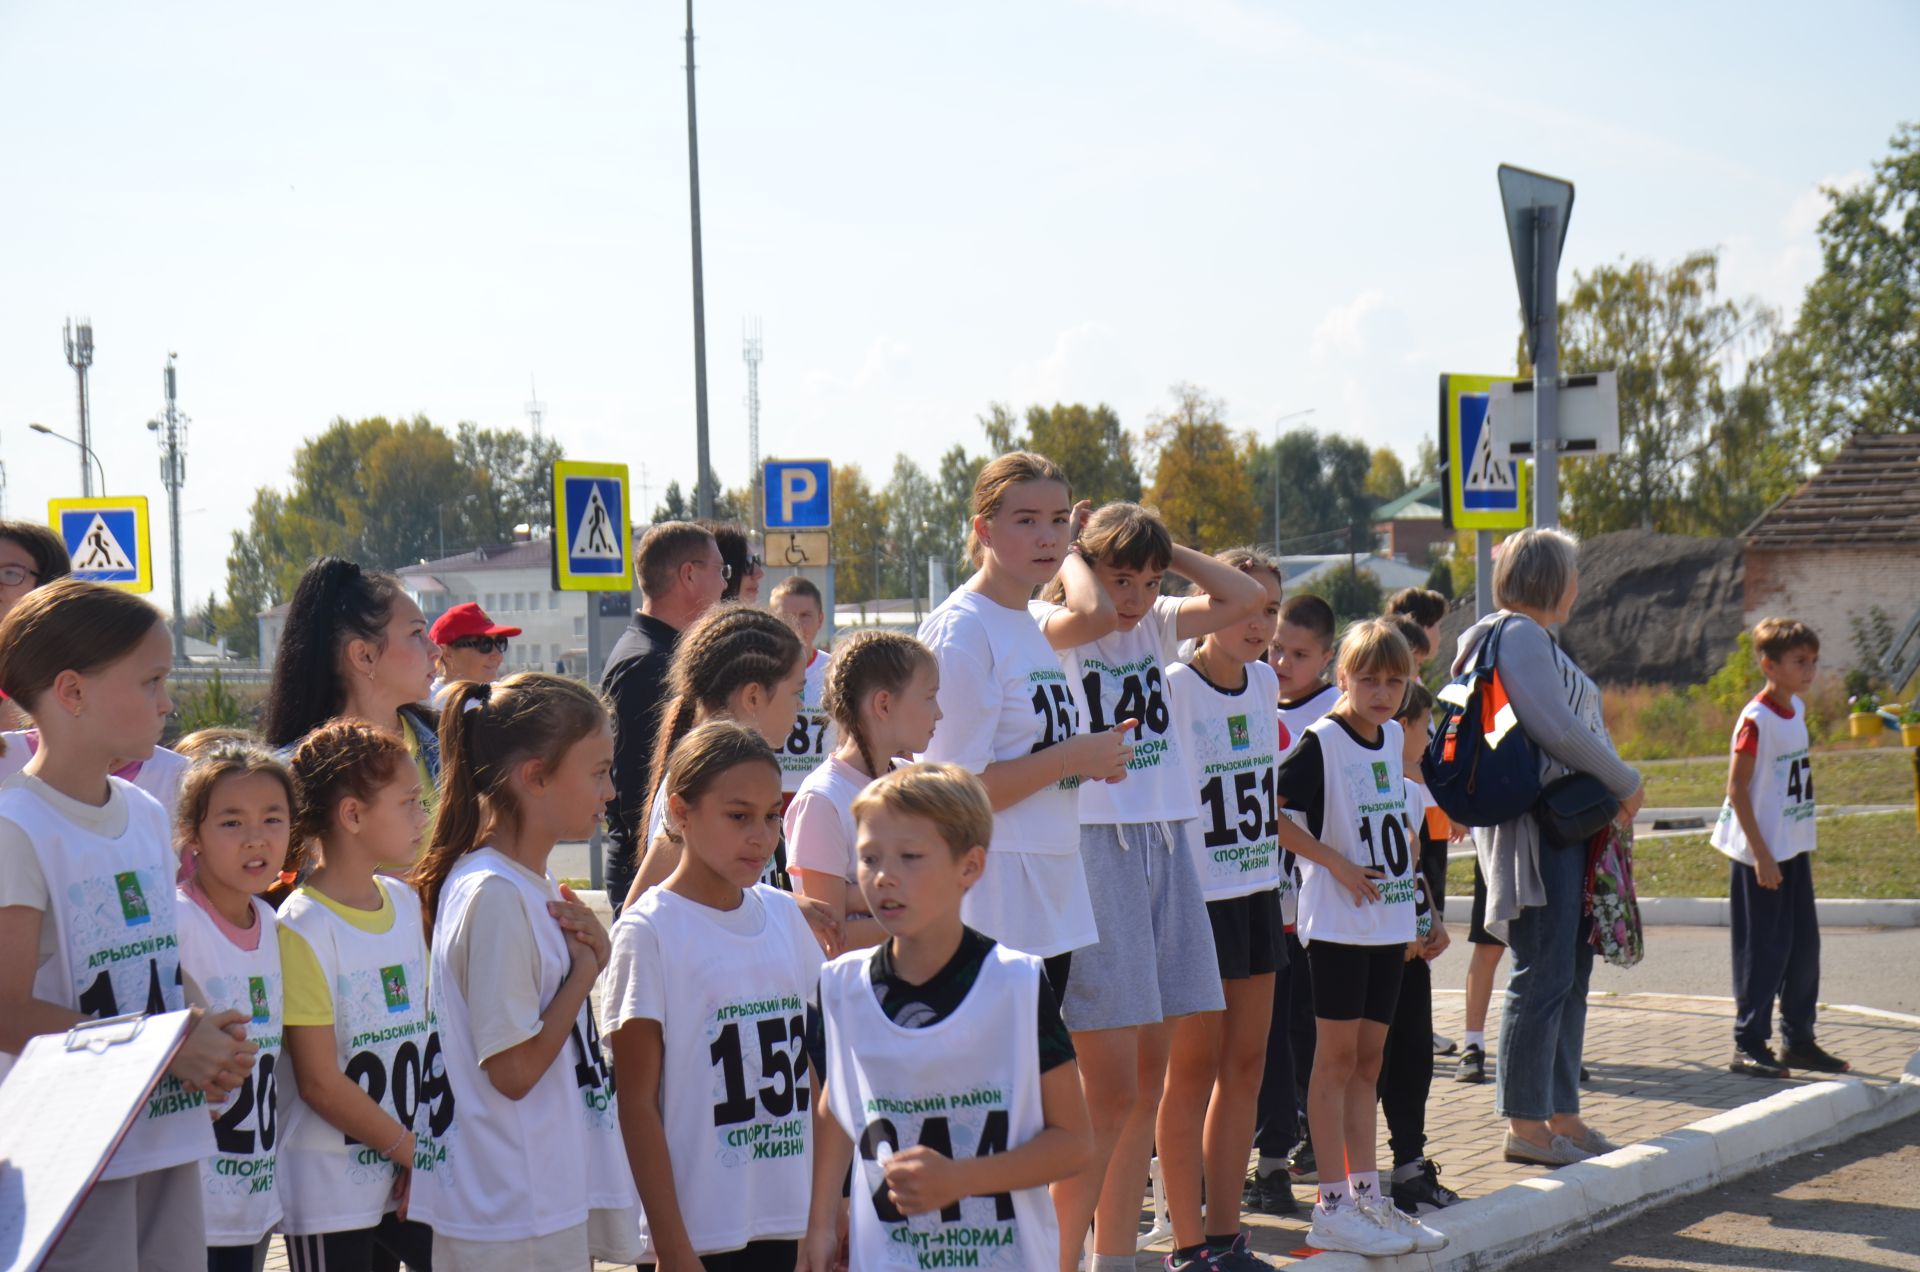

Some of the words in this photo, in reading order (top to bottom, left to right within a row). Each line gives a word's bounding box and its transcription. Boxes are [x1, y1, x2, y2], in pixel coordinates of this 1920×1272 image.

[781, 468, 817, 522] P
[1084, 658, 1135, 677] АГРЫСКИЙ
[1082, 667, 1169, 740] 148
[1126, 755, 1160, 770] ИЗНИ
[1204, 757, 1252, 774] АГРЫЗСКИЙ
[1200, 767, 1278, 848] 151
[1214, 847, 1251, 862] СПОРТ
[1240, 856, 1270, 872] ЖИЗНИ
[1384, 891, 1415, 904] ЖИЗН
[710, 1014, 810, 1127] 152
[950, 1089, 1003, 1109] РАЙОН
[946, 1226, 1014, 1248] НОРМА
